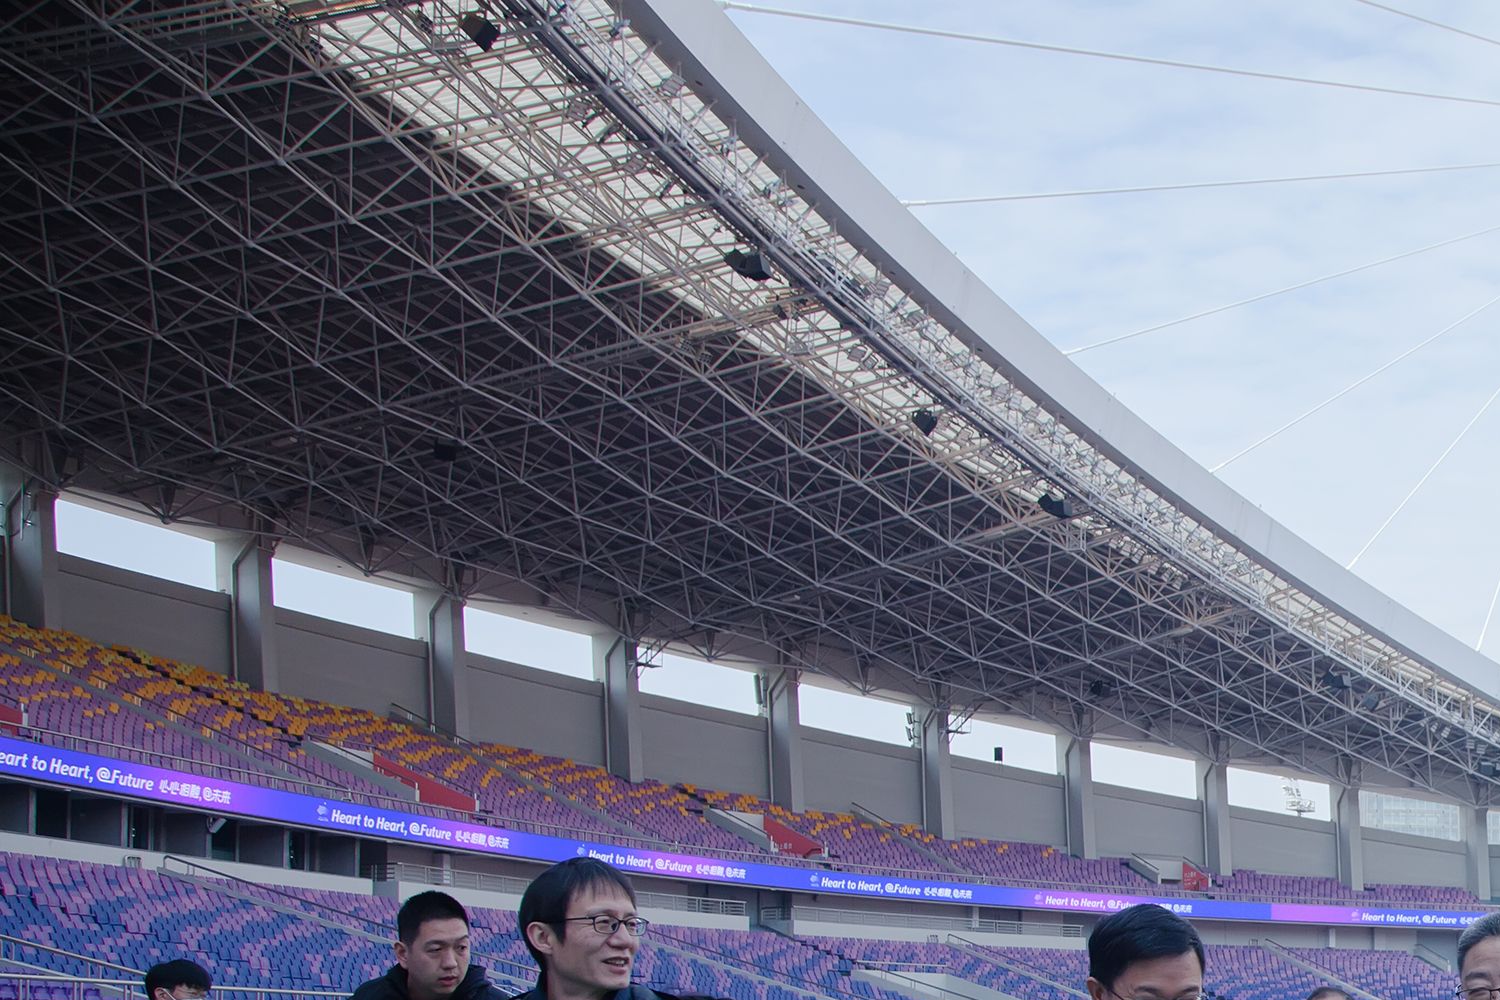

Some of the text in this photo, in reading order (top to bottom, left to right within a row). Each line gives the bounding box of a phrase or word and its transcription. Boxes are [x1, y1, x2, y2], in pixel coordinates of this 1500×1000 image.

[0, 751, 28, 768] eart
[31, 755, 47, 772] to
[50, 758, 94, 783] Heart,
[97, 767, 154, 791] @Future
[331, 809, 361, 826] Heart
[363, 815, 375, 828] to
[376, 816, 408, 836] Heart,
[409, 822, 452, 840] @Future
[615, 853, 626, 866] to
[626, 855, 654, 870] Heart,
[655, 858, 692, 873] @Future
[821, 877, 845, 889] Heart
[847, 880, 857, 890] to
[857, 880, 884, 894] Heart,
[885, 883, 921, 896] @Future
[1045, 896, 1069, 906] Heart
[1070, 897, 1080, 907] to
[1080, 897, 1106, 910] Heart,
[1361, 912, 1385, 922] Heart
[1386, 913, 1396, 922] to
[1396, 913, 1422, 925] Heart,
[1422, 915, 1457, 925] @Future
